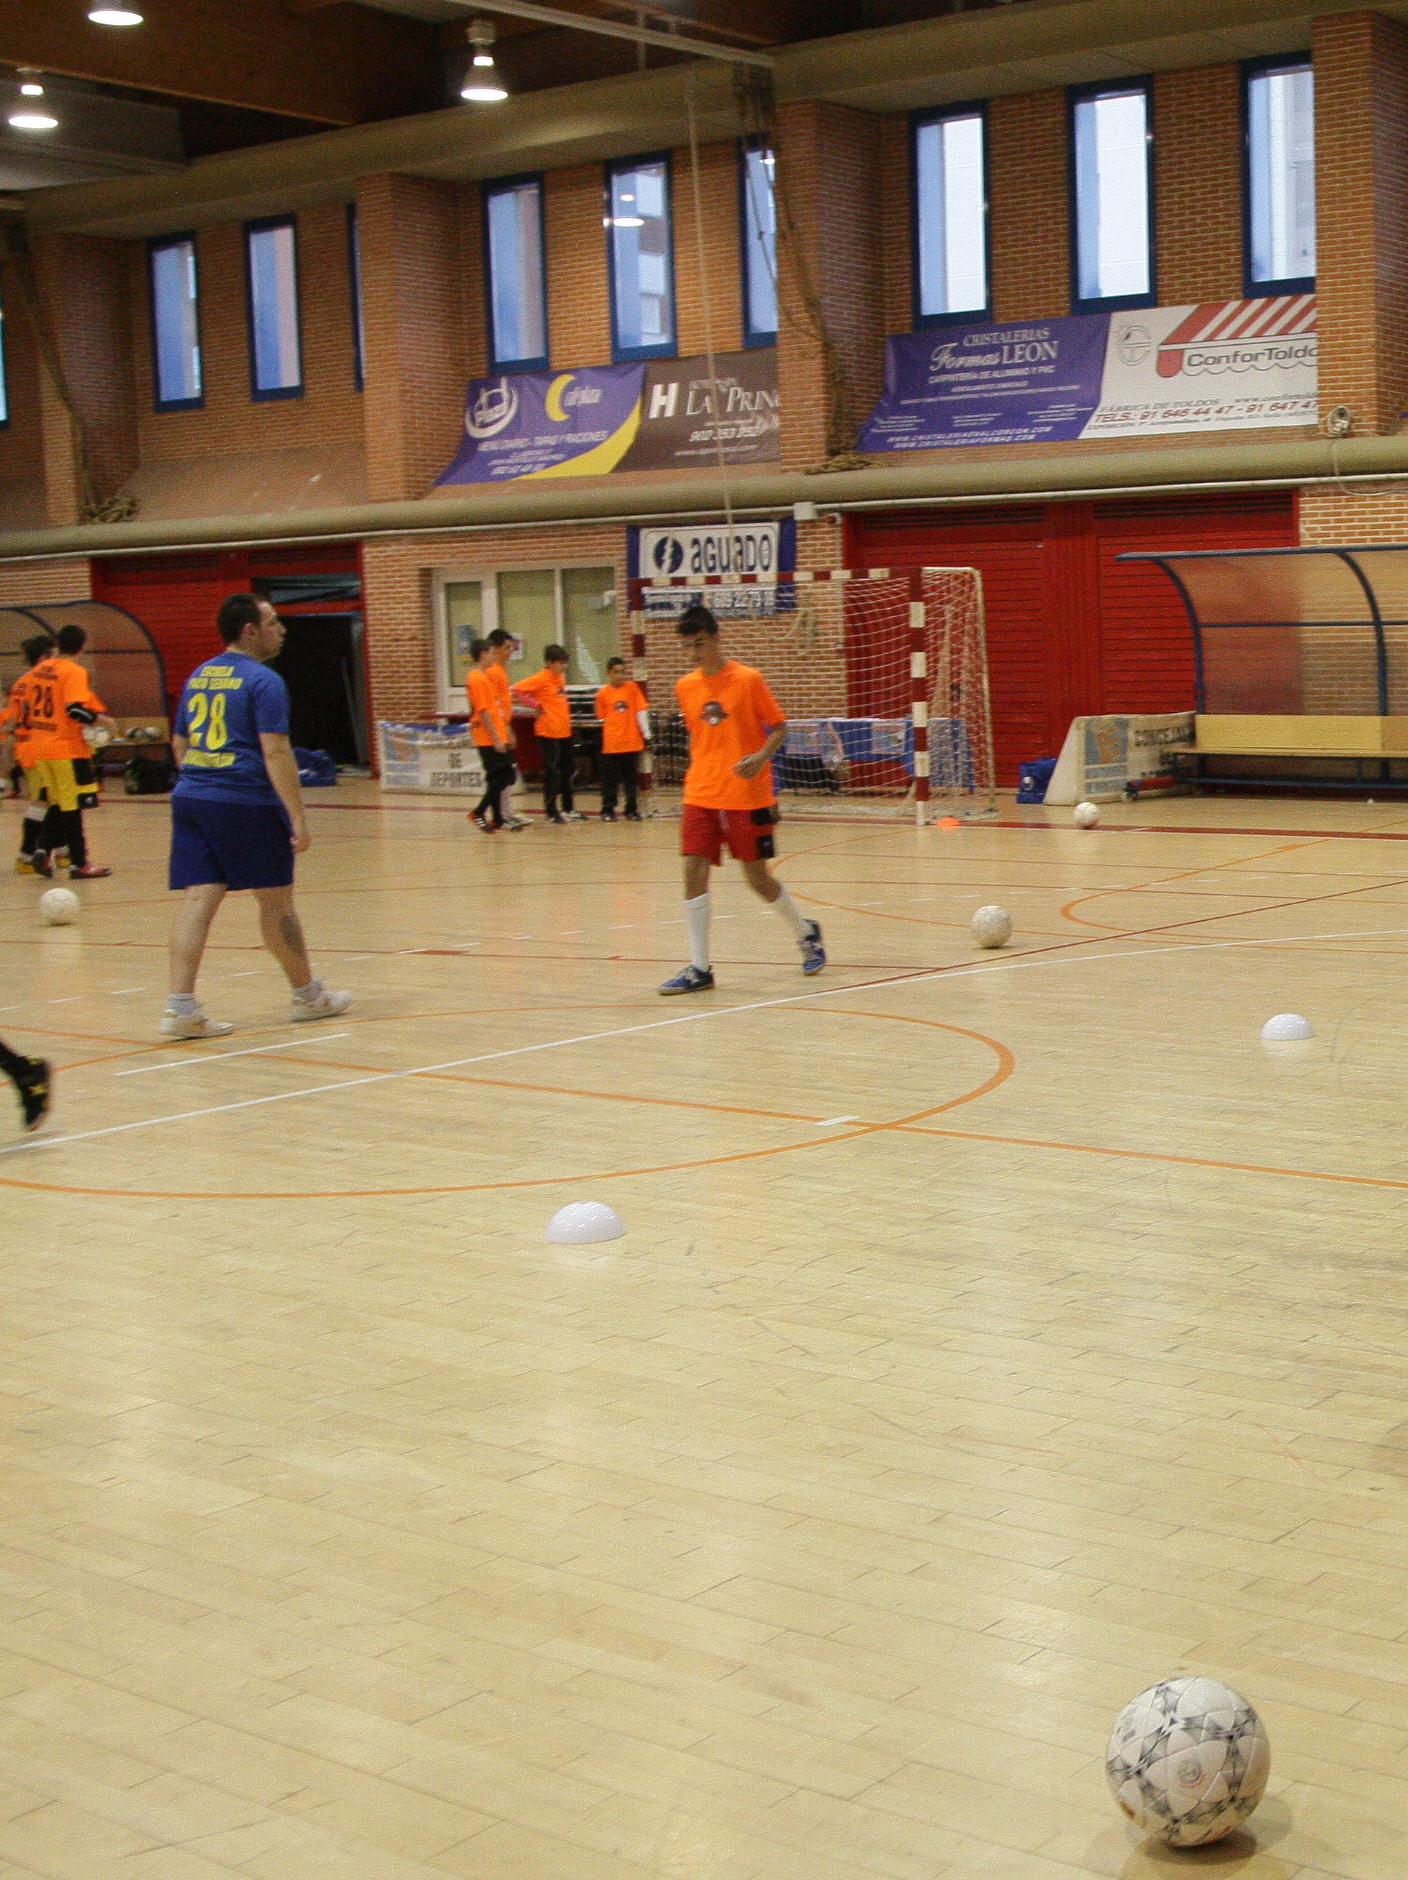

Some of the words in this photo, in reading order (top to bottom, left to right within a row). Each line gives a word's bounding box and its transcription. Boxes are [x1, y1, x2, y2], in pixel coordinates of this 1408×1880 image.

[929, 342, 1000, 371] Formas
[1002, 341, 1059, 364] LEON
[186, 692, 229, 751] 28
